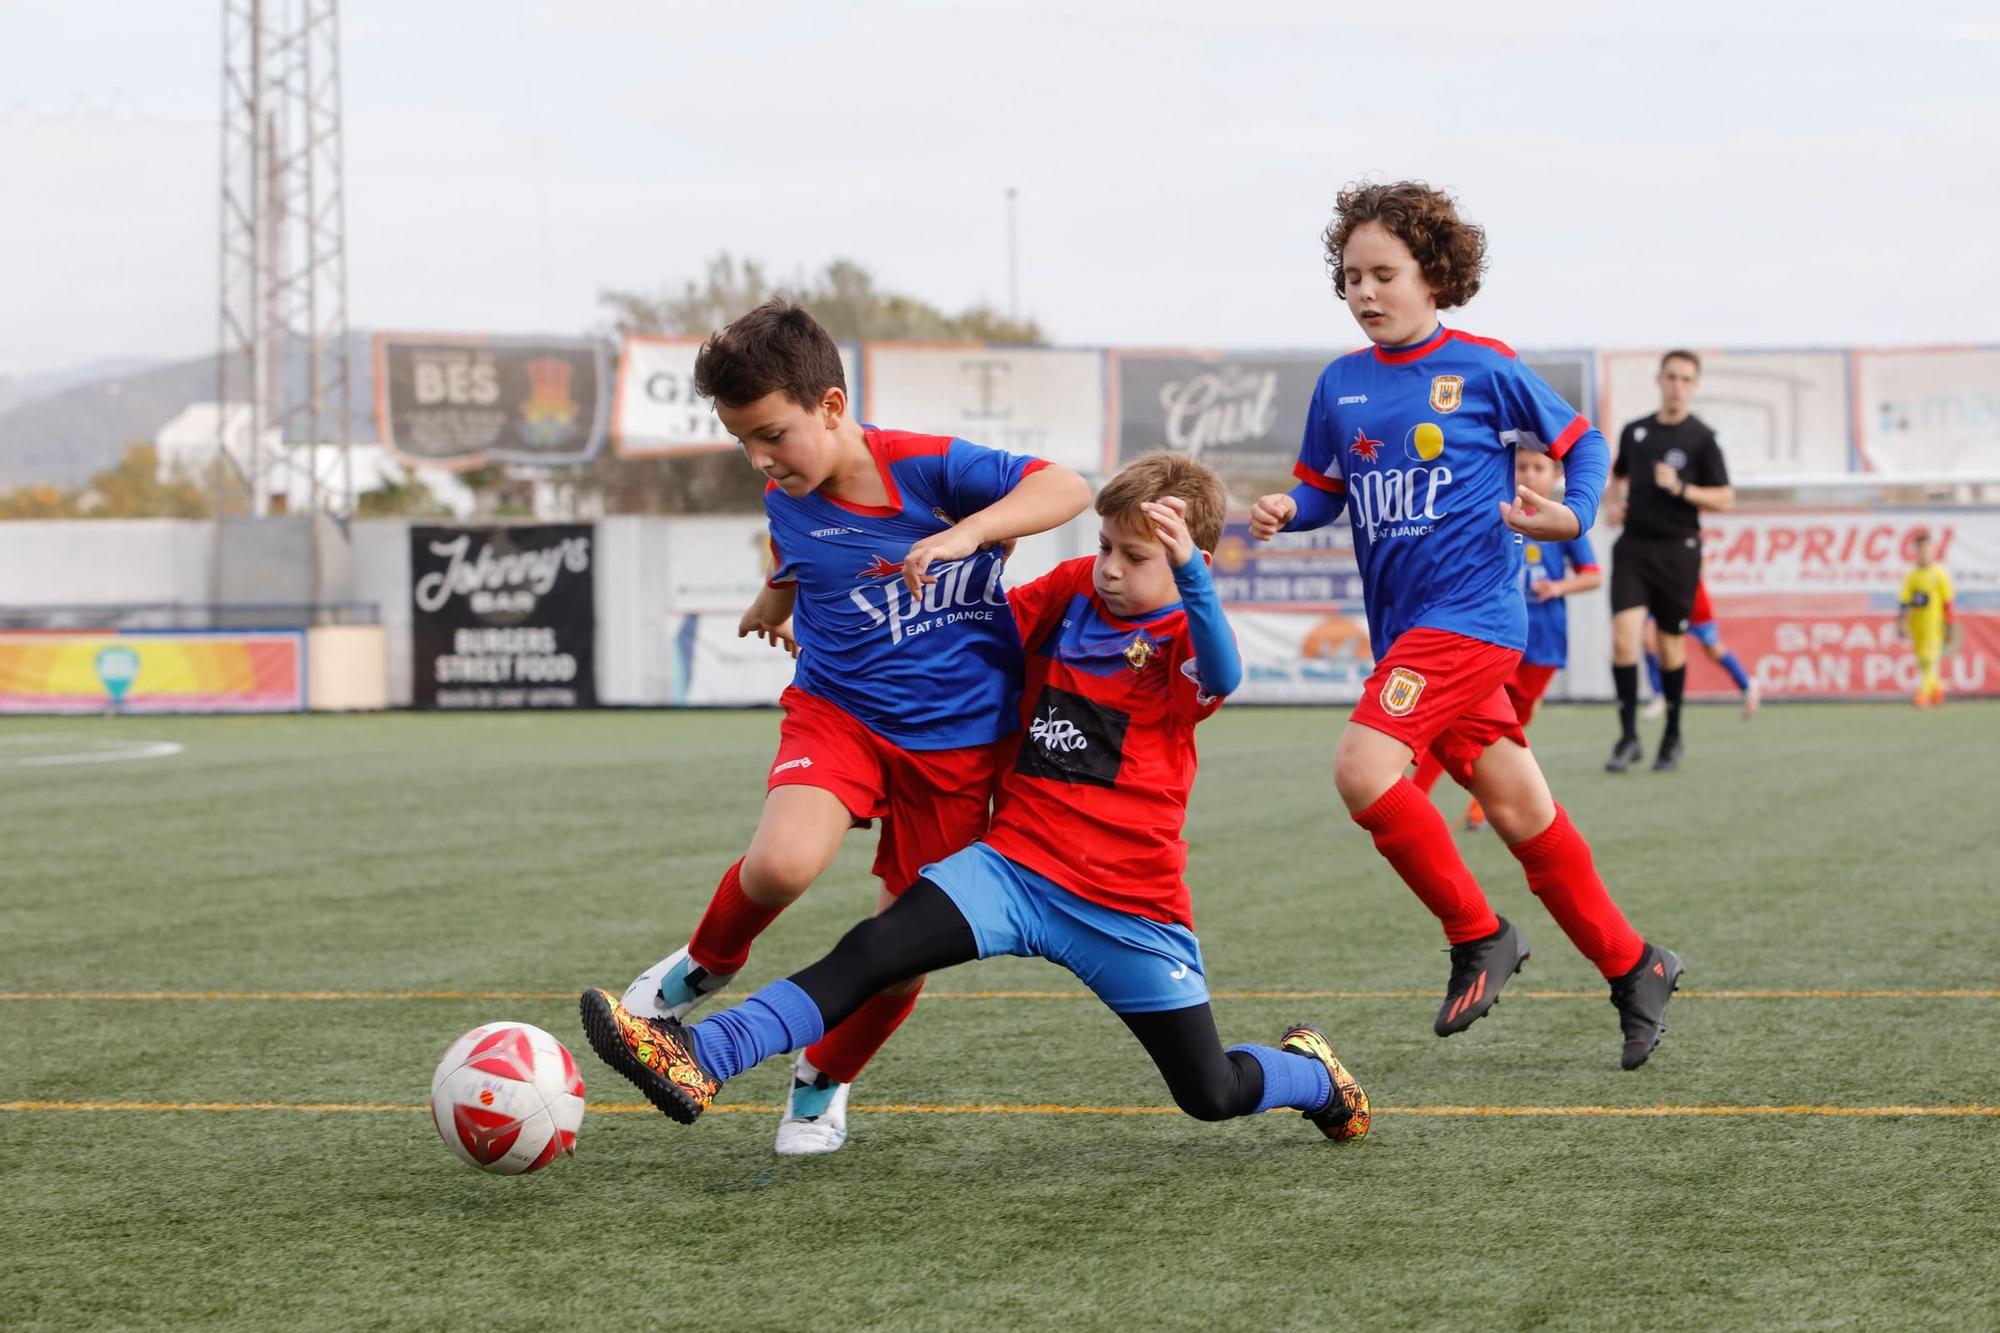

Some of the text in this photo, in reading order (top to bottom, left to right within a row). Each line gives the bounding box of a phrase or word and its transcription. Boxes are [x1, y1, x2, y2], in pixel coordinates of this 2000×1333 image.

[414, 362, 498, 404] BES
[415, 534, 589, 612] Johnny's
[454, 627, 557, 655] BURGERS
[905, 610, 995, 637] EAT & DANCE
[434, 652, 578, 683] STREET FOOD
[1756, 653, 1849, 692] CAN
